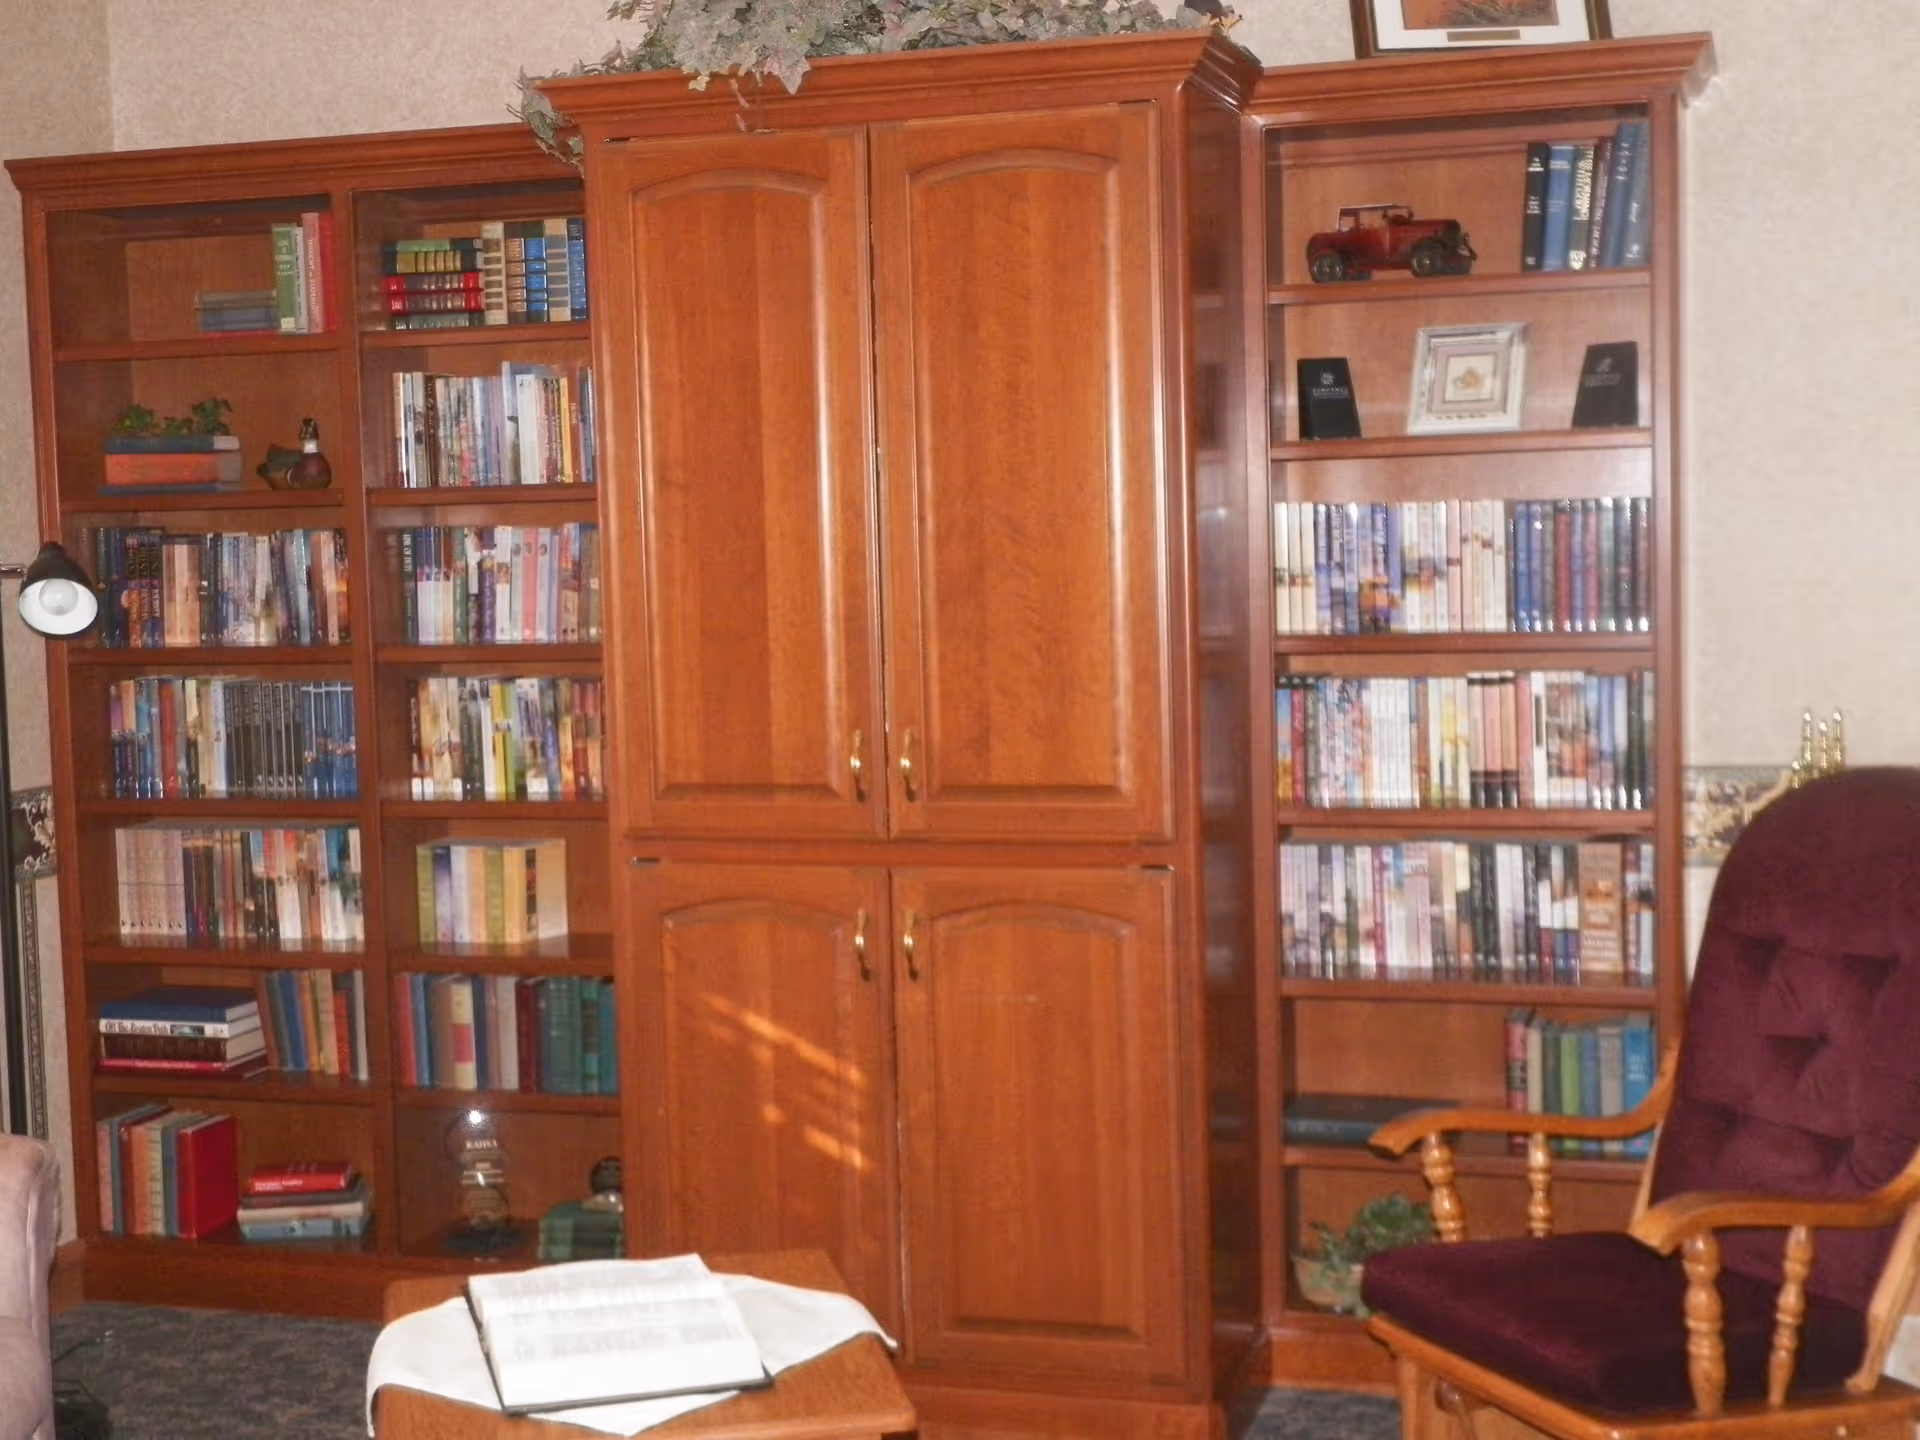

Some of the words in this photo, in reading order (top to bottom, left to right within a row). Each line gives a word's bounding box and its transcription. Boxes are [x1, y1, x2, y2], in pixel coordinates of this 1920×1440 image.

[306, 239, 315, 270] THOUGHT
[403, 534, 412, 546] LINE
[118, 1022, 129, 1034] The
[130, 1022, 152, 1035] Beaten
[152, 1023, 170, 1036] Path
